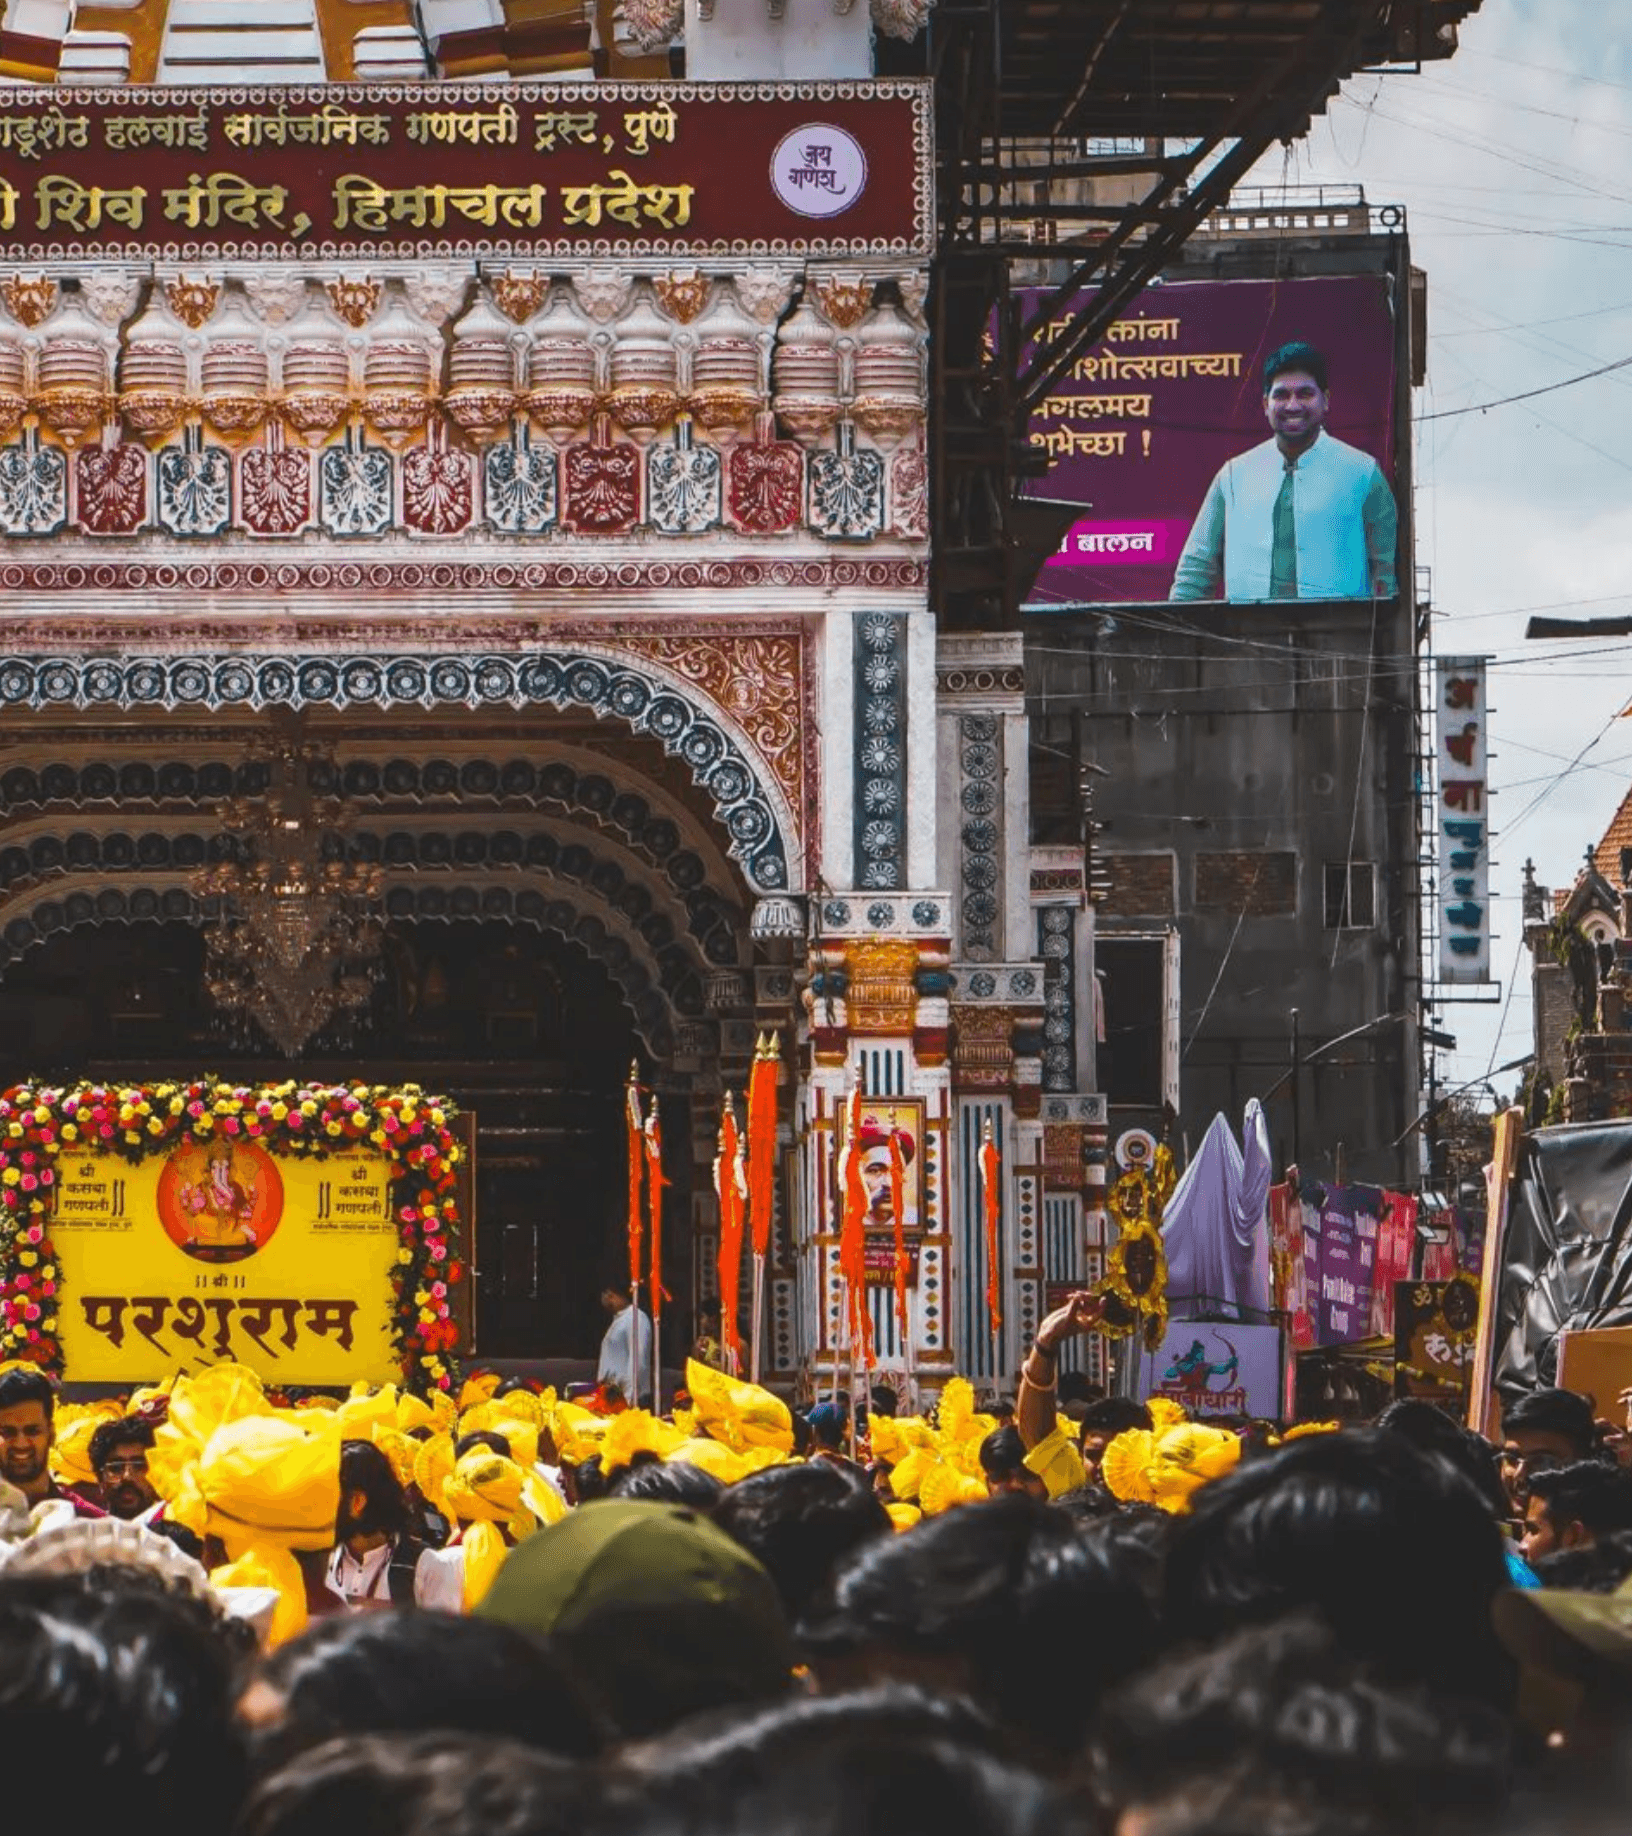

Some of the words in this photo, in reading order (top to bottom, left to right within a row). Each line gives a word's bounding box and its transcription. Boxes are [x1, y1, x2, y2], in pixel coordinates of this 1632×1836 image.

[105, 105, 208, 150] हलवाई
[224, 104, 390, 147] सार्वजनिक
[406, 104, 519, 144] गणपती
[535, 110, 614, 154] ट्रस्ट,
[624, 101, 678, 155] पुणे
[798, 145, 832, 168] जय
[789, 167, 847, 195] गणेश
[33, 172, 147, 231] शिव
[162, 172, 313, 237] मंदिर,
[331, 174, 546, 230] हिमाचल
[561, 170, 695, 230] प्रदेश
[1106, 310, 1181, 342] क्तांना
[1066, 347, 1243, 381] शोत्सवाच्या
[1142, 430, 1151, 456] !
[1077, 533, 1154, 552] बालन
[213, 1273, 228, 1288] श्री
[80, 1296, 360, 1362] परशुराम
